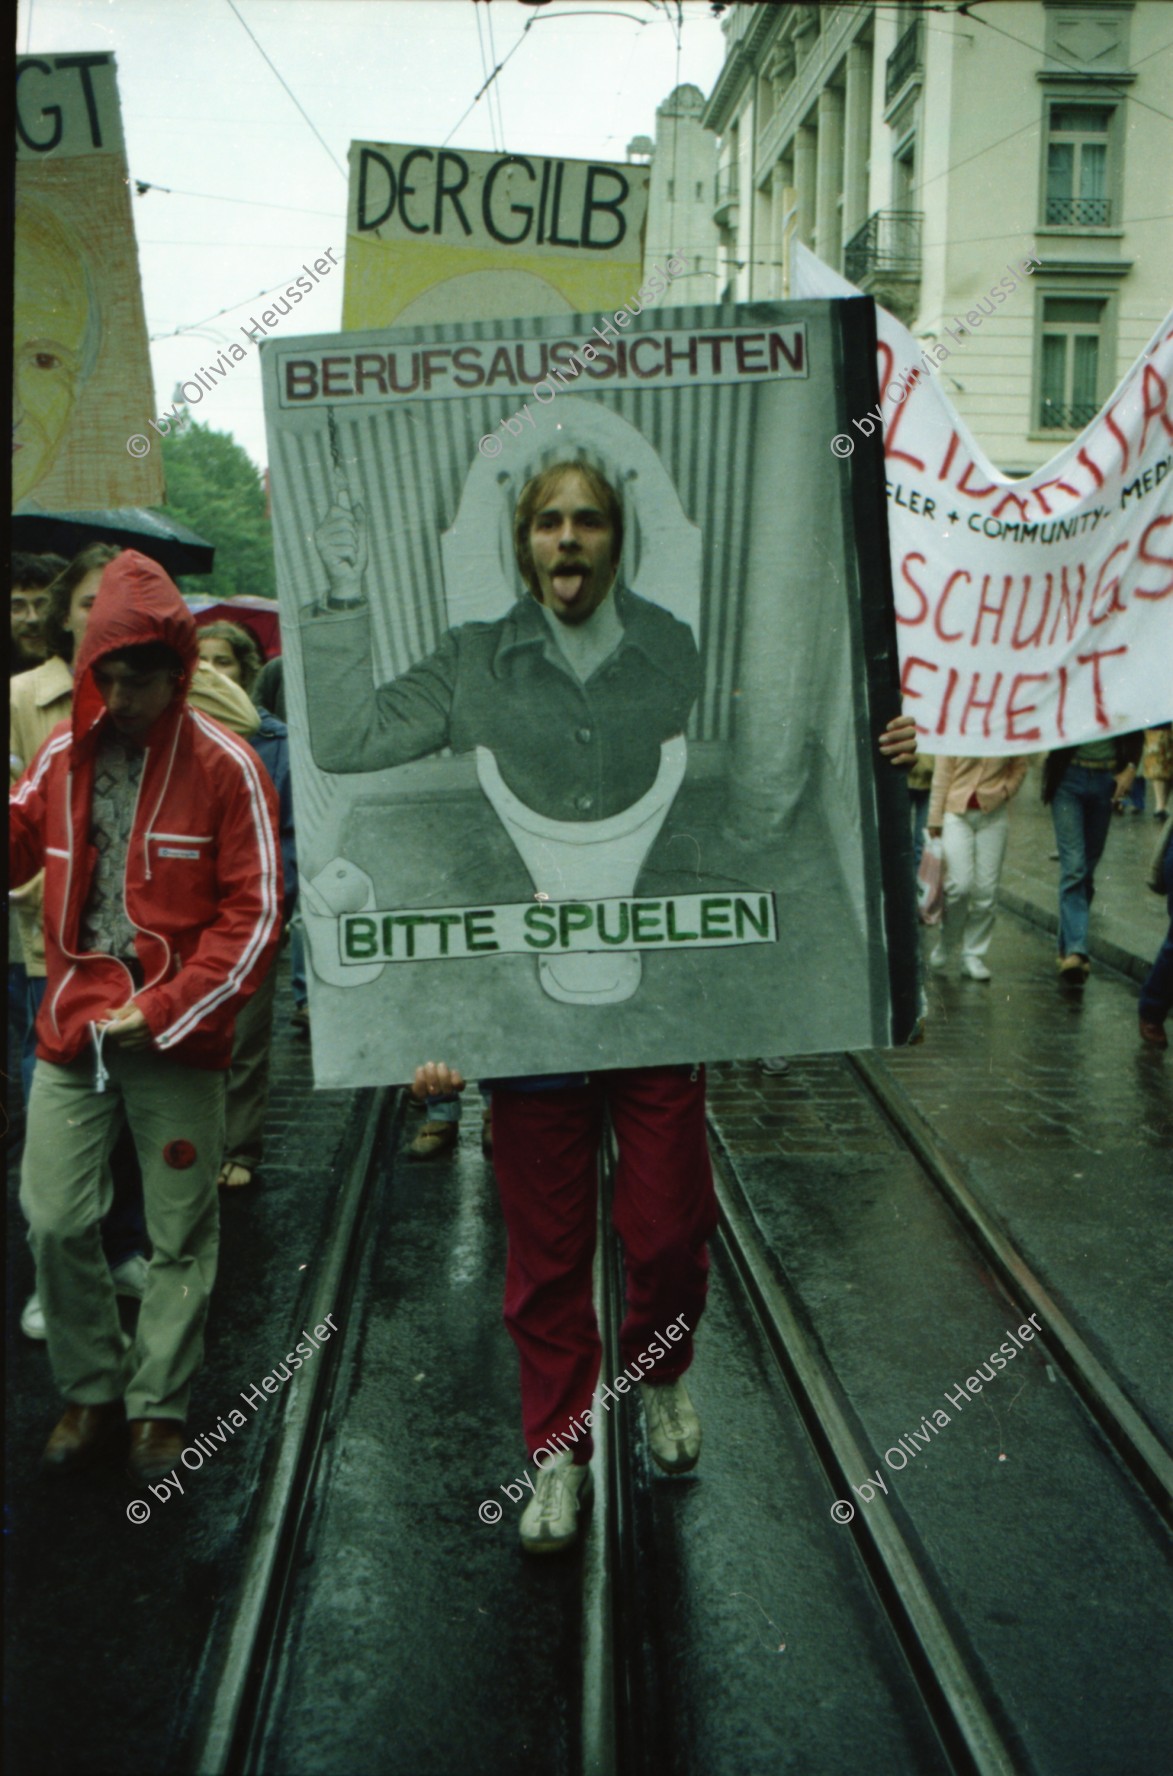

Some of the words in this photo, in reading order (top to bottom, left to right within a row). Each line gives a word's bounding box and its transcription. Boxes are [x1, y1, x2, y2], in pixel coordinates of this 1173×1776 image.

[16, 55, 109, 152] GT
[357, 148, 472, 236] DER
[482, 155, 629, 250] GILB
[285, 332, 804, 401] BERUFSAUSSICHTEN
[896, 514, 1173, 652] SCHUNGS
[345, 910, 499, 958] BITTE
[523, 896, 769, 948] SPUELEN
